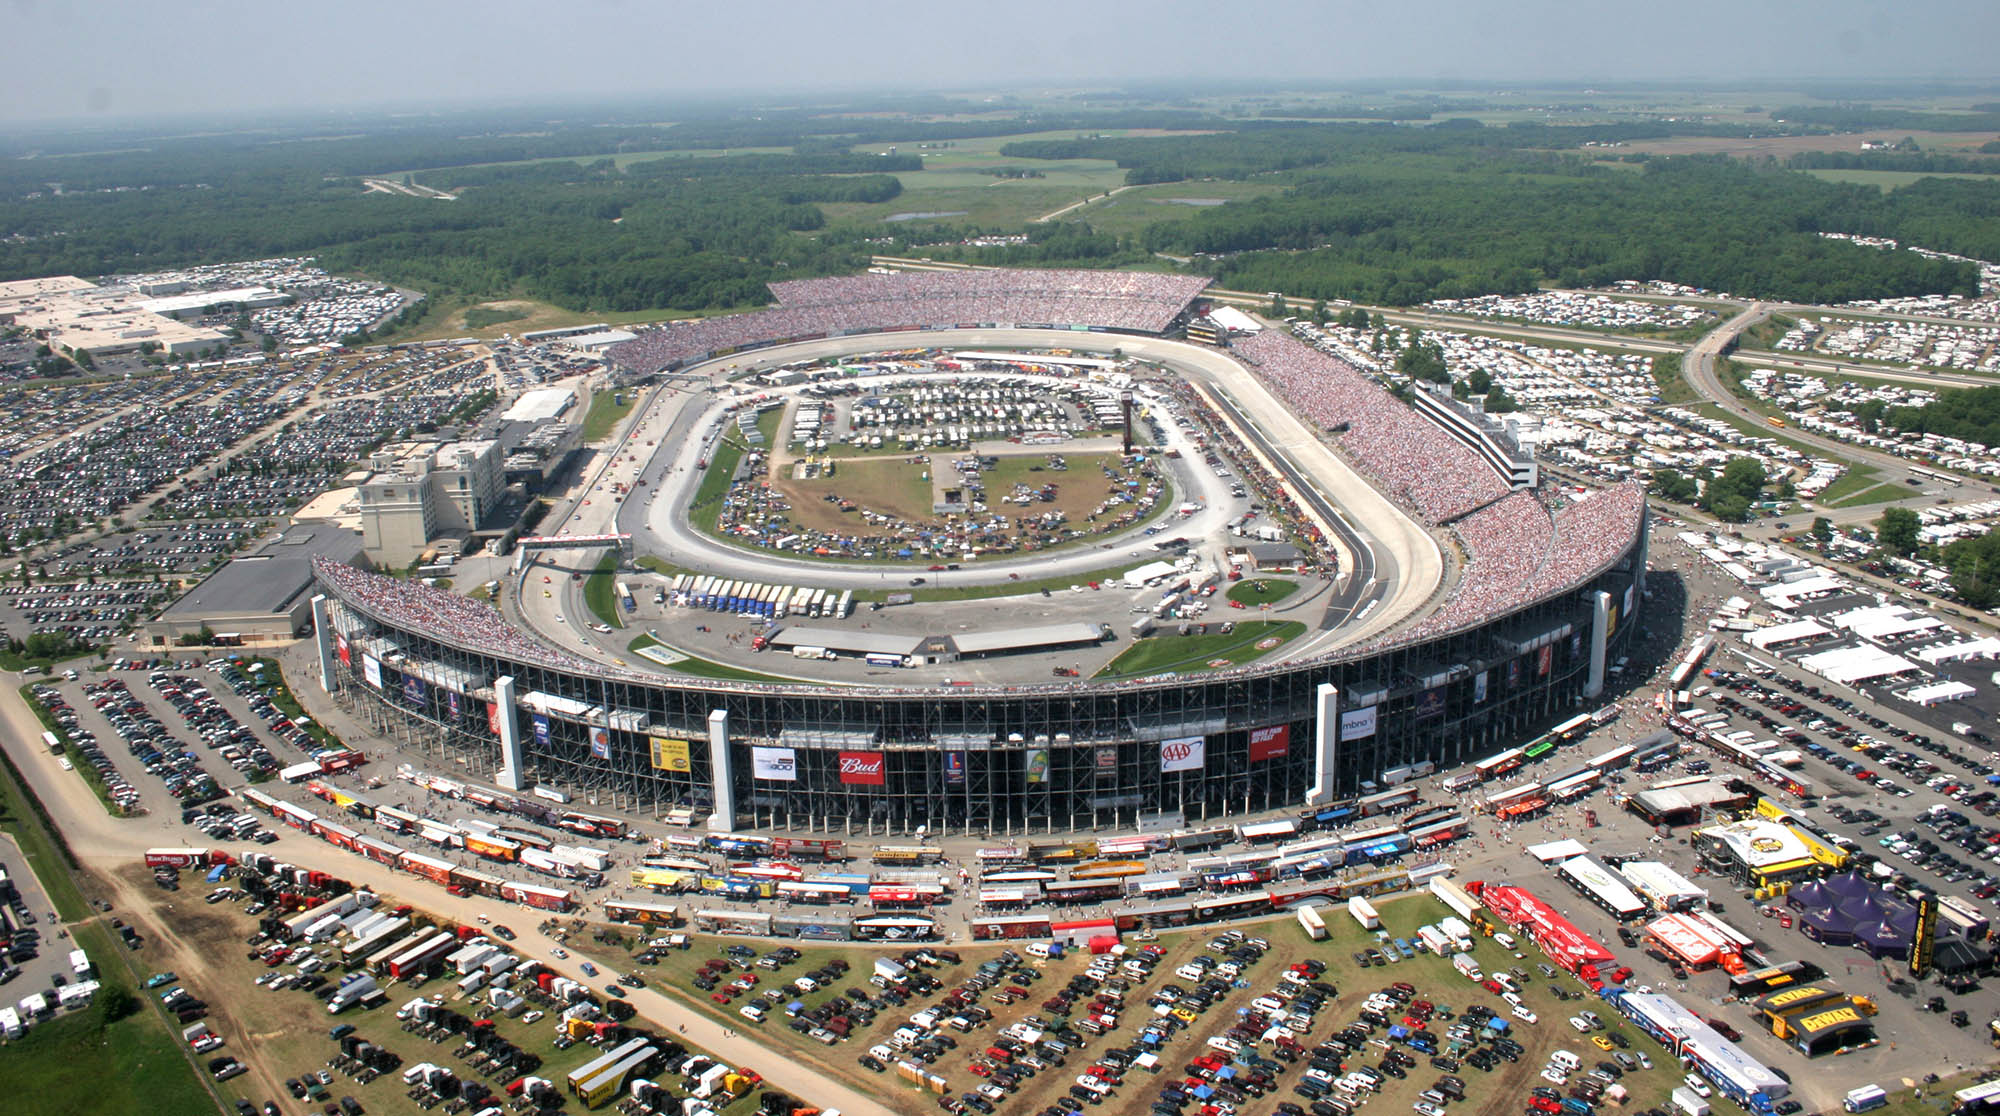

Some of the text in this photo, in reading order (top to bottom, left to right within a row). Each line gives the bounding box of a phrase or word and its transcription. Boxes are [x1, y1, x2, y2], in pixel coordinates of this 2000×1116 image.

[1343, 719, 1368, 730] mbna
[1165, 744, 1190, 760] AAA
[840, 758, 881, 773] Bud
[1800, 1007, 1862, 1033] DEWALT
